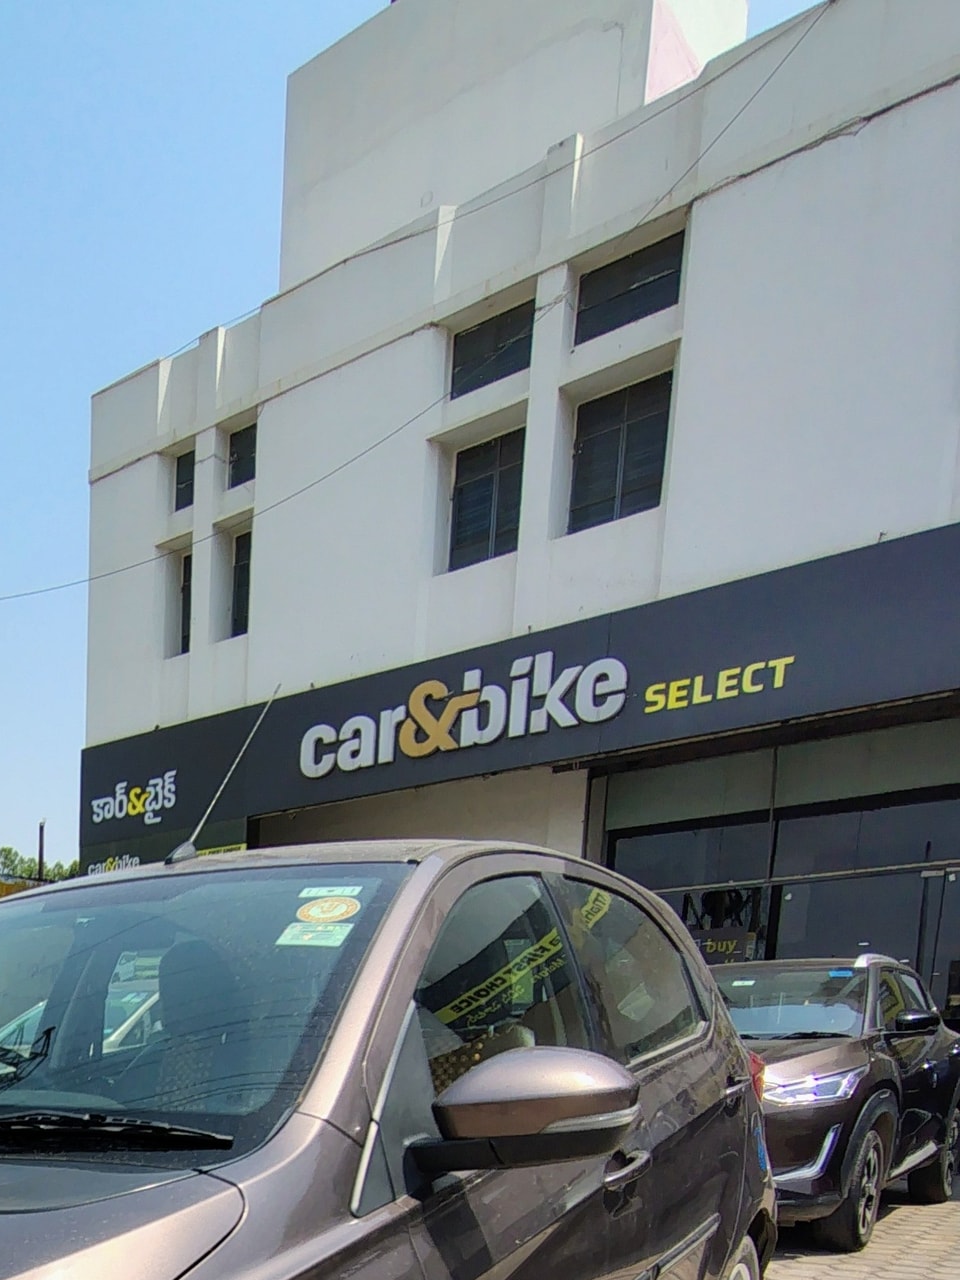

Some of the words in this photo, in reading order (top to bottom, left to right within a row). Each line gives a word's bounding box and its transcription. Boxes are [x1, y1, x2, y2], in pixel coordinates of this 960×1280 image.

[300, 651, 628, 779] car&bike
[644, 655, 795, 714] SELECT
[91, 769, 177, 825] కార్&బైక్
[706, 938, 737, 954] buy
